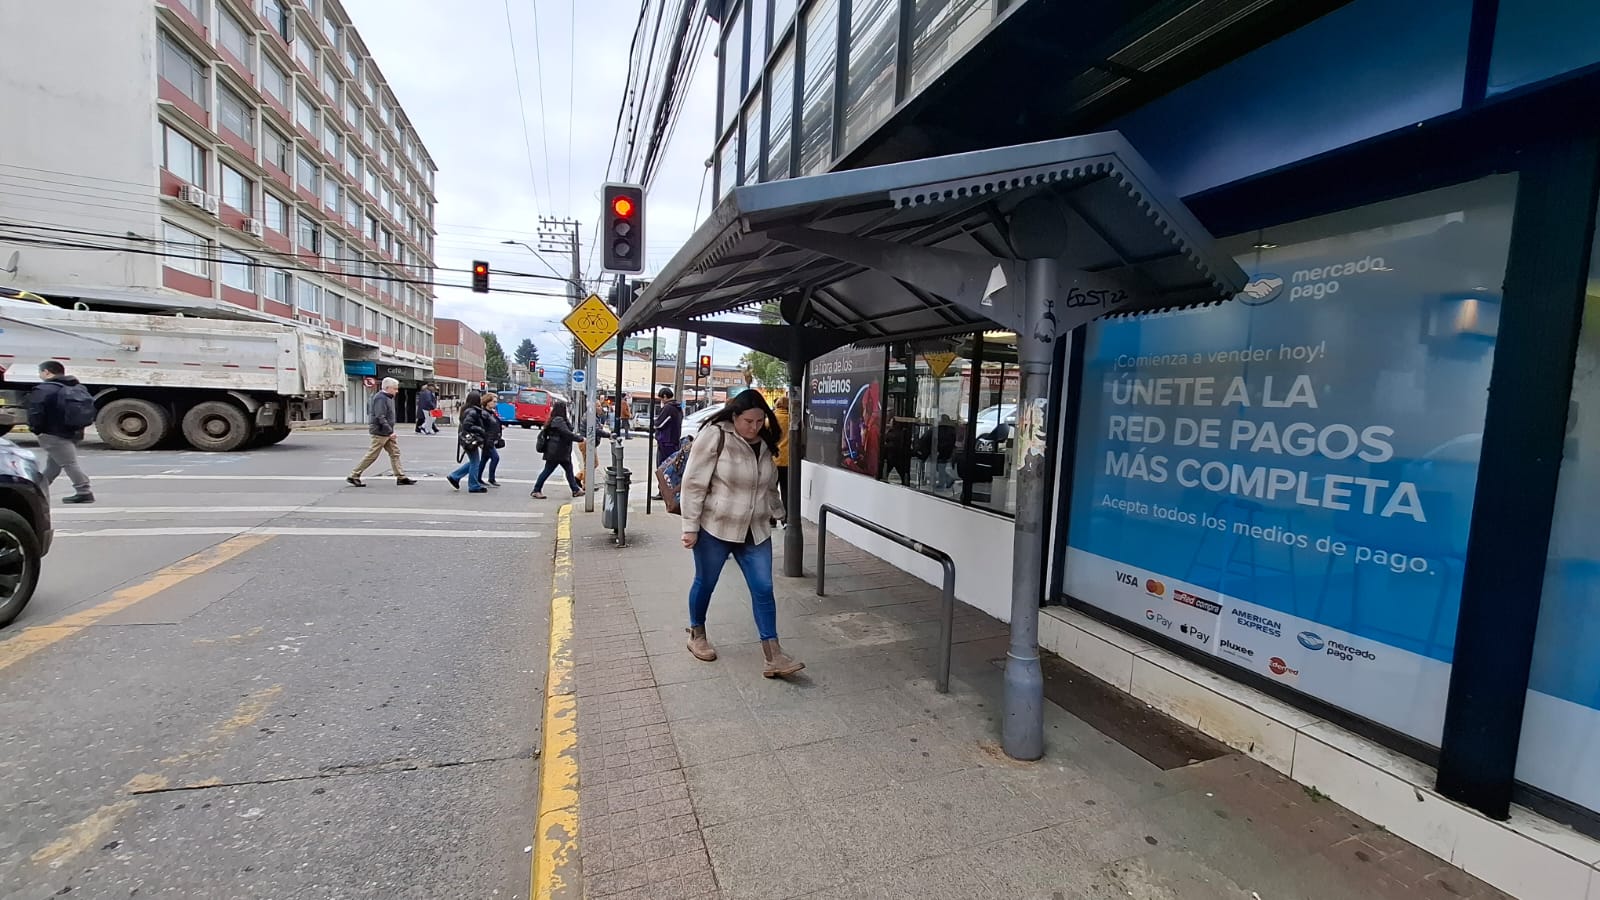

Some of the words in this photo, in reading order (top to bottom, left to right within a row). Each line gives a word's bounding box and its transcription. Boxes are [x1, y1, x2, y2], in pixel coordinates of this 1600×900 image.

[1292, 255, 1385, 283] mercado
[1289, 280, 1339, 302] pago
[811, 360, 819, 375] La
[833, 358, 842, 373] de
[842, 355, 853, 372] los
[1113, 351, 1187, 371] ¡Comienza
[1192, 354, 1200, 364] a
[1208, 346, 1272, 363] vender
[1279, 340, 1326, 363] hoy!
[818, 375, 850, 393] chilenos
[1112, 372, 1215, 405] ÚNETE
[1221, 376, 1251, 407] A
[1262, 374, 1319, 409] LA
[1108, 415, 1166, 444] RED
[1173, 417, 1221, 449] DE
[1230, 420, 1395, 463] PAGOS
[1105, 447, 1169, 483] MÁS
[1176, 458, 1427, 523] COMPLETA
[1102, 494, 1149, 516] Acepta
[1153, 502, 1197, 525] todos
[1202, 512, 1227, 531] los
[1233, 522, 1308, 548] medios
[1316, 536, 1347, 556] de
[1355, 546, 1436, 575] pago.
[1115, 570, 1139, 588] VISA
[1156, 613, 1173, 629] Pay
[1231, 608, 1282, 630] AMERICAN
[1237, 617, 1281, 638] EXPRESS
[1189, 626, 1210, 644] Pay
[1219, 638, 1254, 656] pluxee
[1326, 648, 1354, 662] pago
[1327, 640, 1376, 661] mercado
